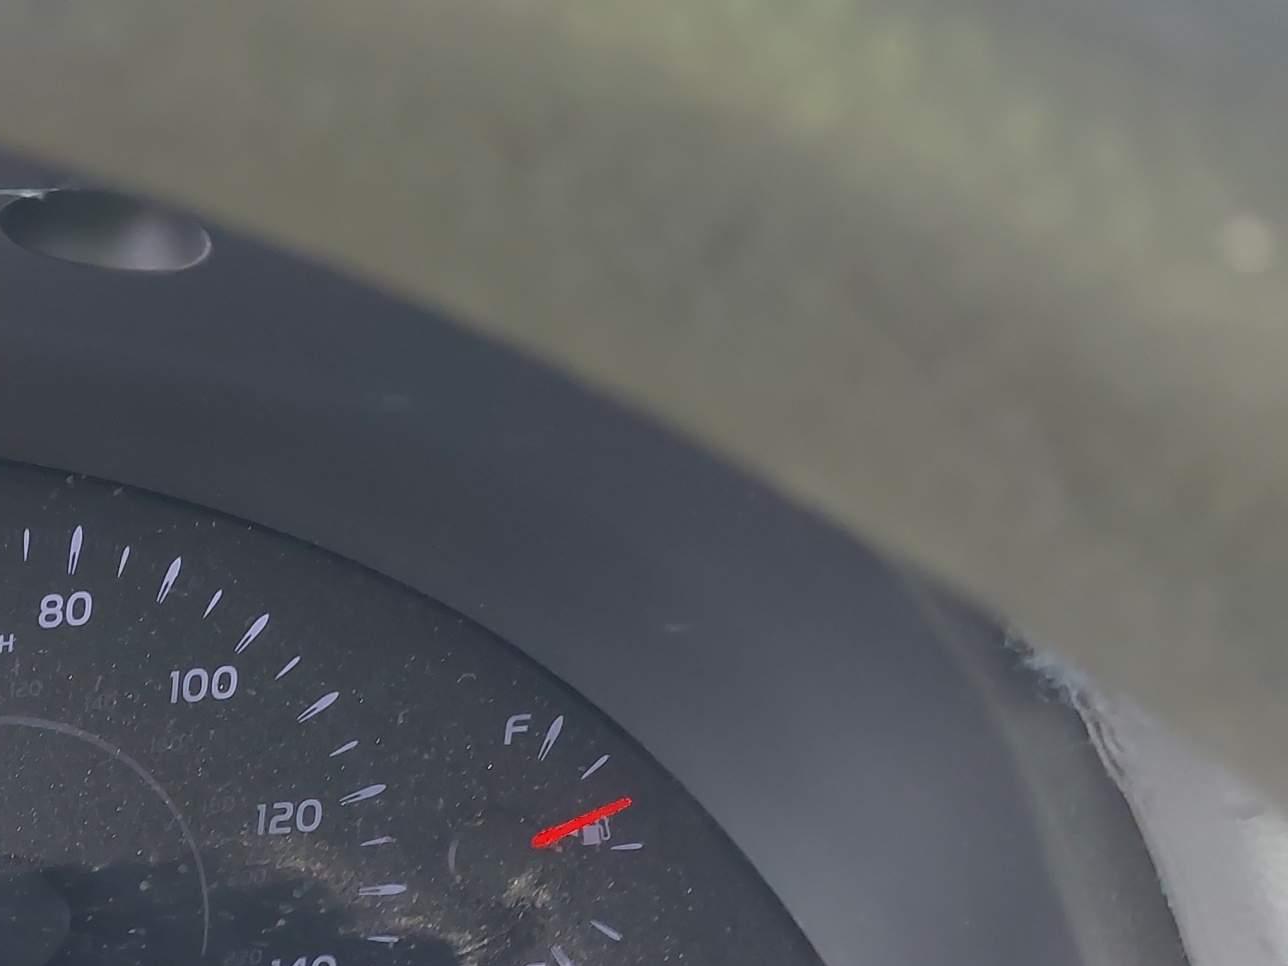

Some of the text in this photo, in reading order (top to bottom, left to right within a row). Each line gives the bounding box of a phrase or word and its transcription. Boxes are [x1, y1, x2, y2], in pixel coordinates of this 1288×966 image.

[38, 590, 93, 629] 80
[169, 664, 239, 704] 100
[503, 714, 532, 746] F
[255, 798, 323, 836] 120
